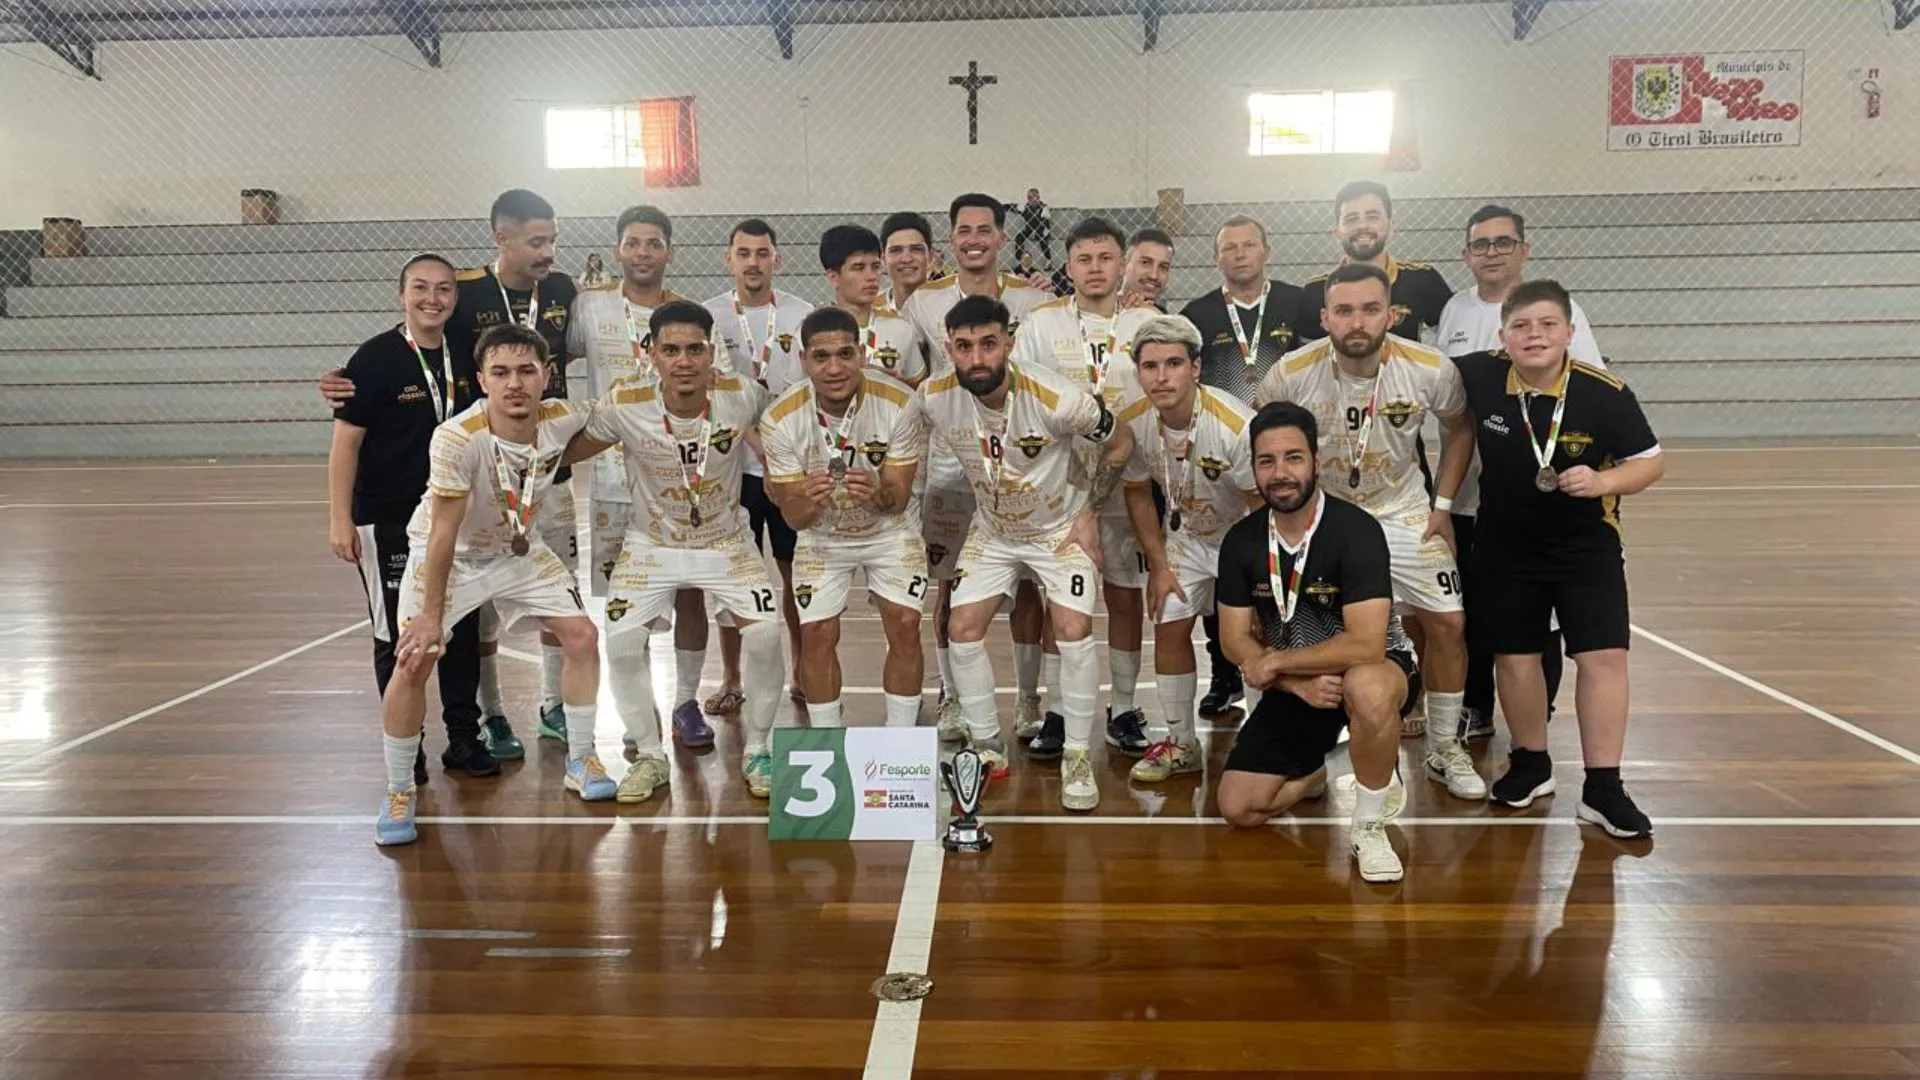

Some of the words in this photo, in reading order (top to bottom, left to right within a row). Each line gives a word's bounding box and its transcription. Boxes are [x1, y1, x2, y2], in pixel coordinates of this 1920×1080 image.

[1649, 131, 1691, 147] Tirol
[1699, 130, 1783, 145] Brasileiro
[678, 442, 698, 464] 12
[908, 575, 928, 600] 27
[1070, 574, 1084, 597] 8
[1437, 570, 1461, 595] 90
[751, 589, 775, 612] 12
[880, 763, 931, 778] Fesporte
[783, 750, 836, 817] 3
[888, 801, 930, 809] CATARINA
